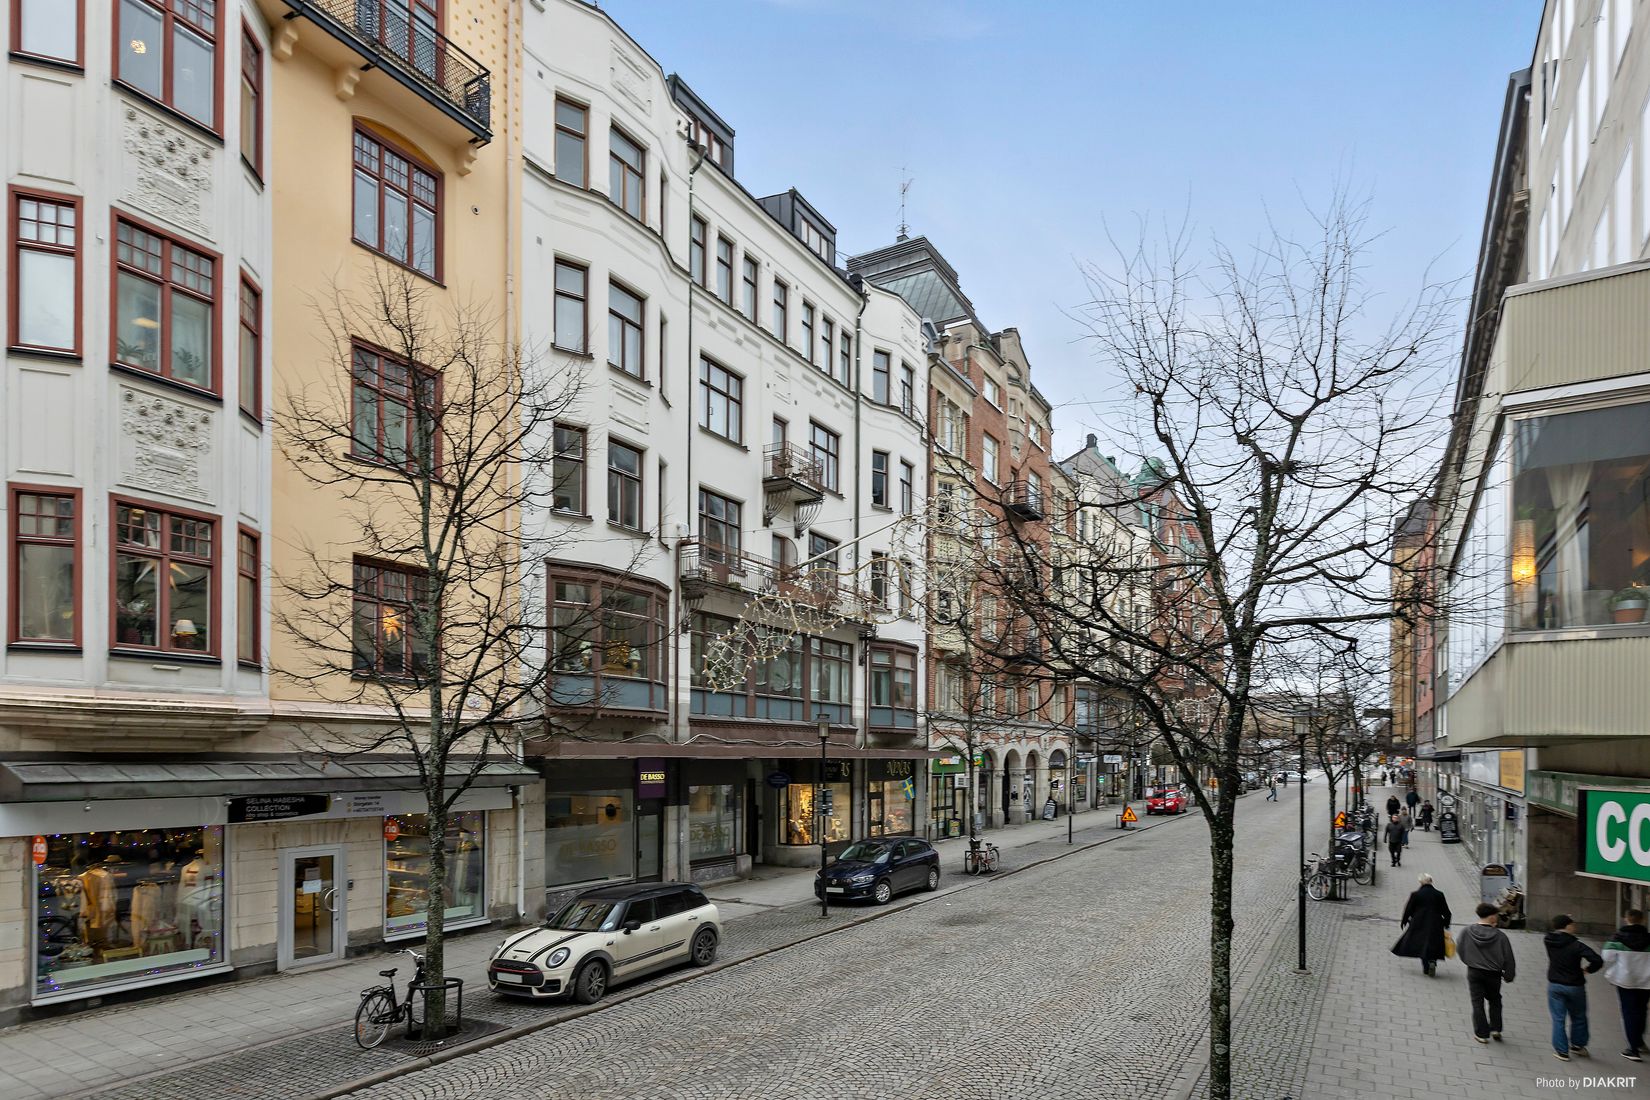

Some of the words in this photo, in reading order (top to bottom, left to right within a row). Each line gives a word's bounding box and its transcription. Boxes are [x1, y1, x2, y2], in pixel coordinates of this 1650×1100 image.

[640, 773, 648, 781] DE
[273, 796, 305, 804] HABESHA
[245, 804, 290, 813] COLLECTION
